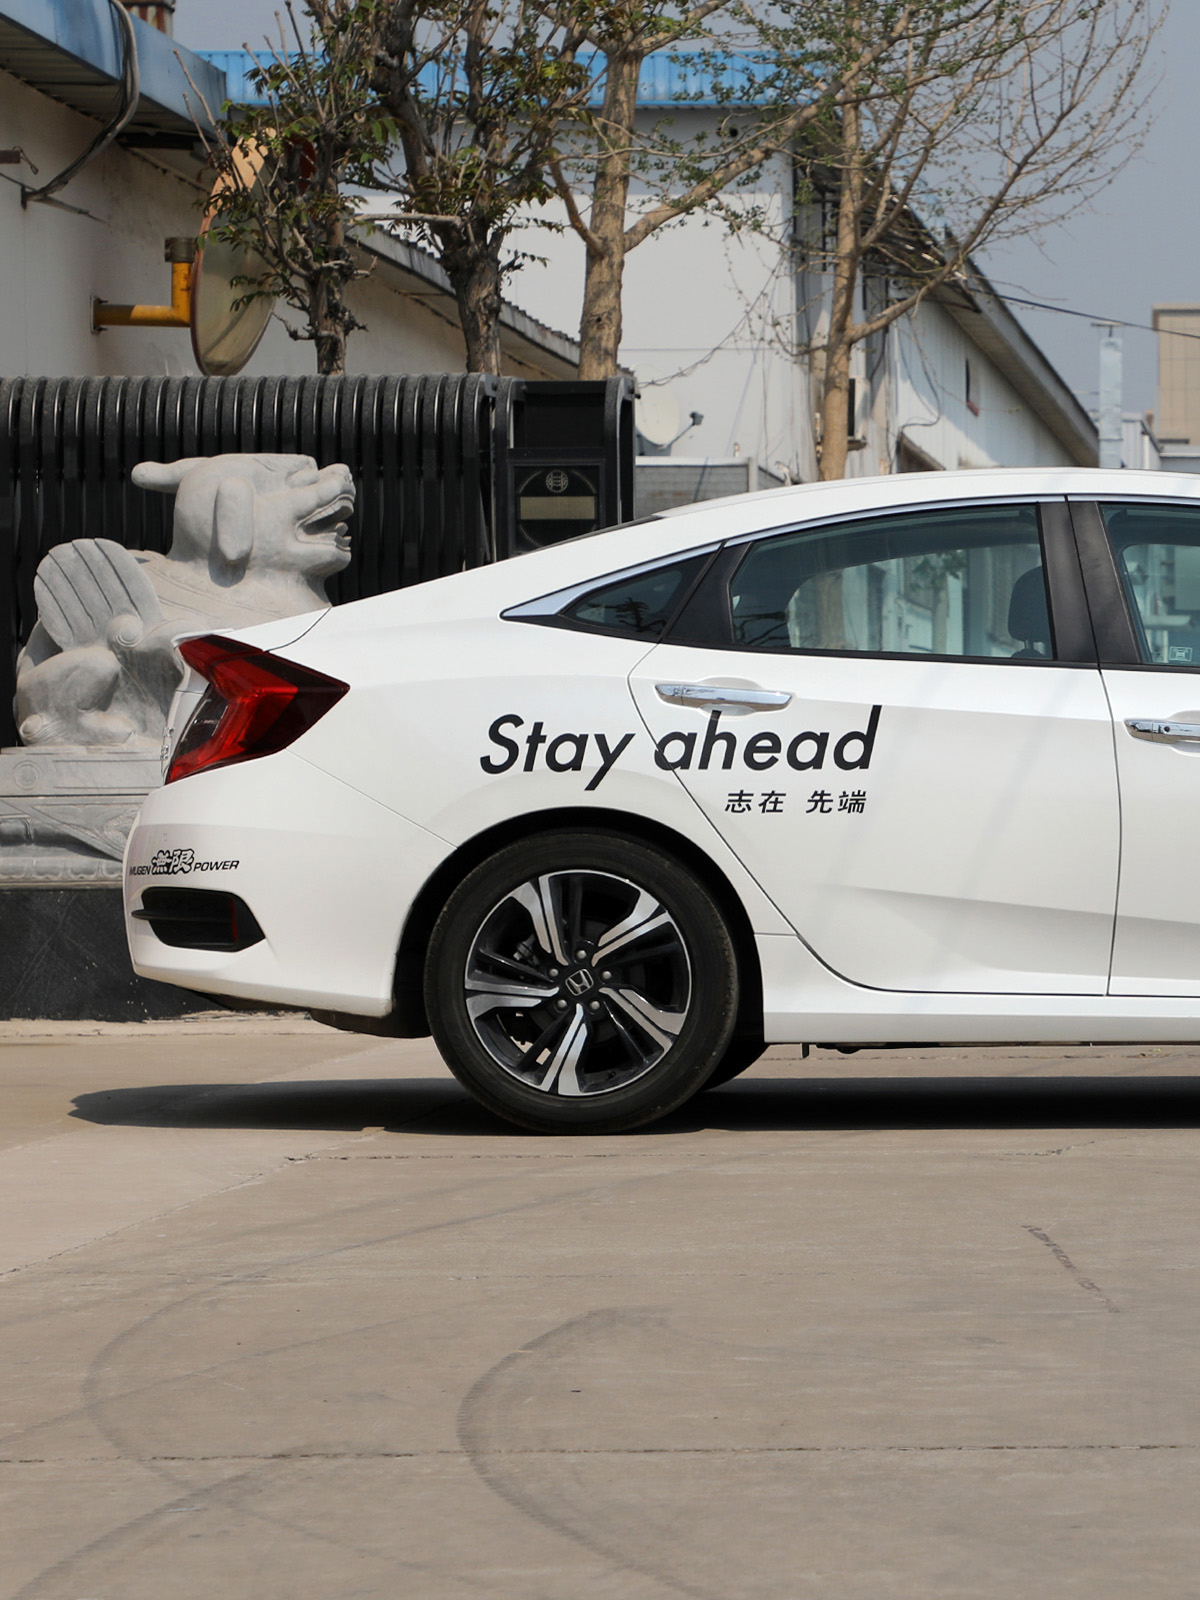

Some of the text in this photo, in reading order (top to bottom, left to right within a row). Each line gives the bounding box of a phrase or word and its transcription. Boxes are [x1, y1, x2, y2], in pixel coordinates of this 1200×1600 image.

[480, 705, 882, 791] Stay ahead
[725, 790, 867, 814] 志在 先端
[193, 860, 240, 872] POWER
